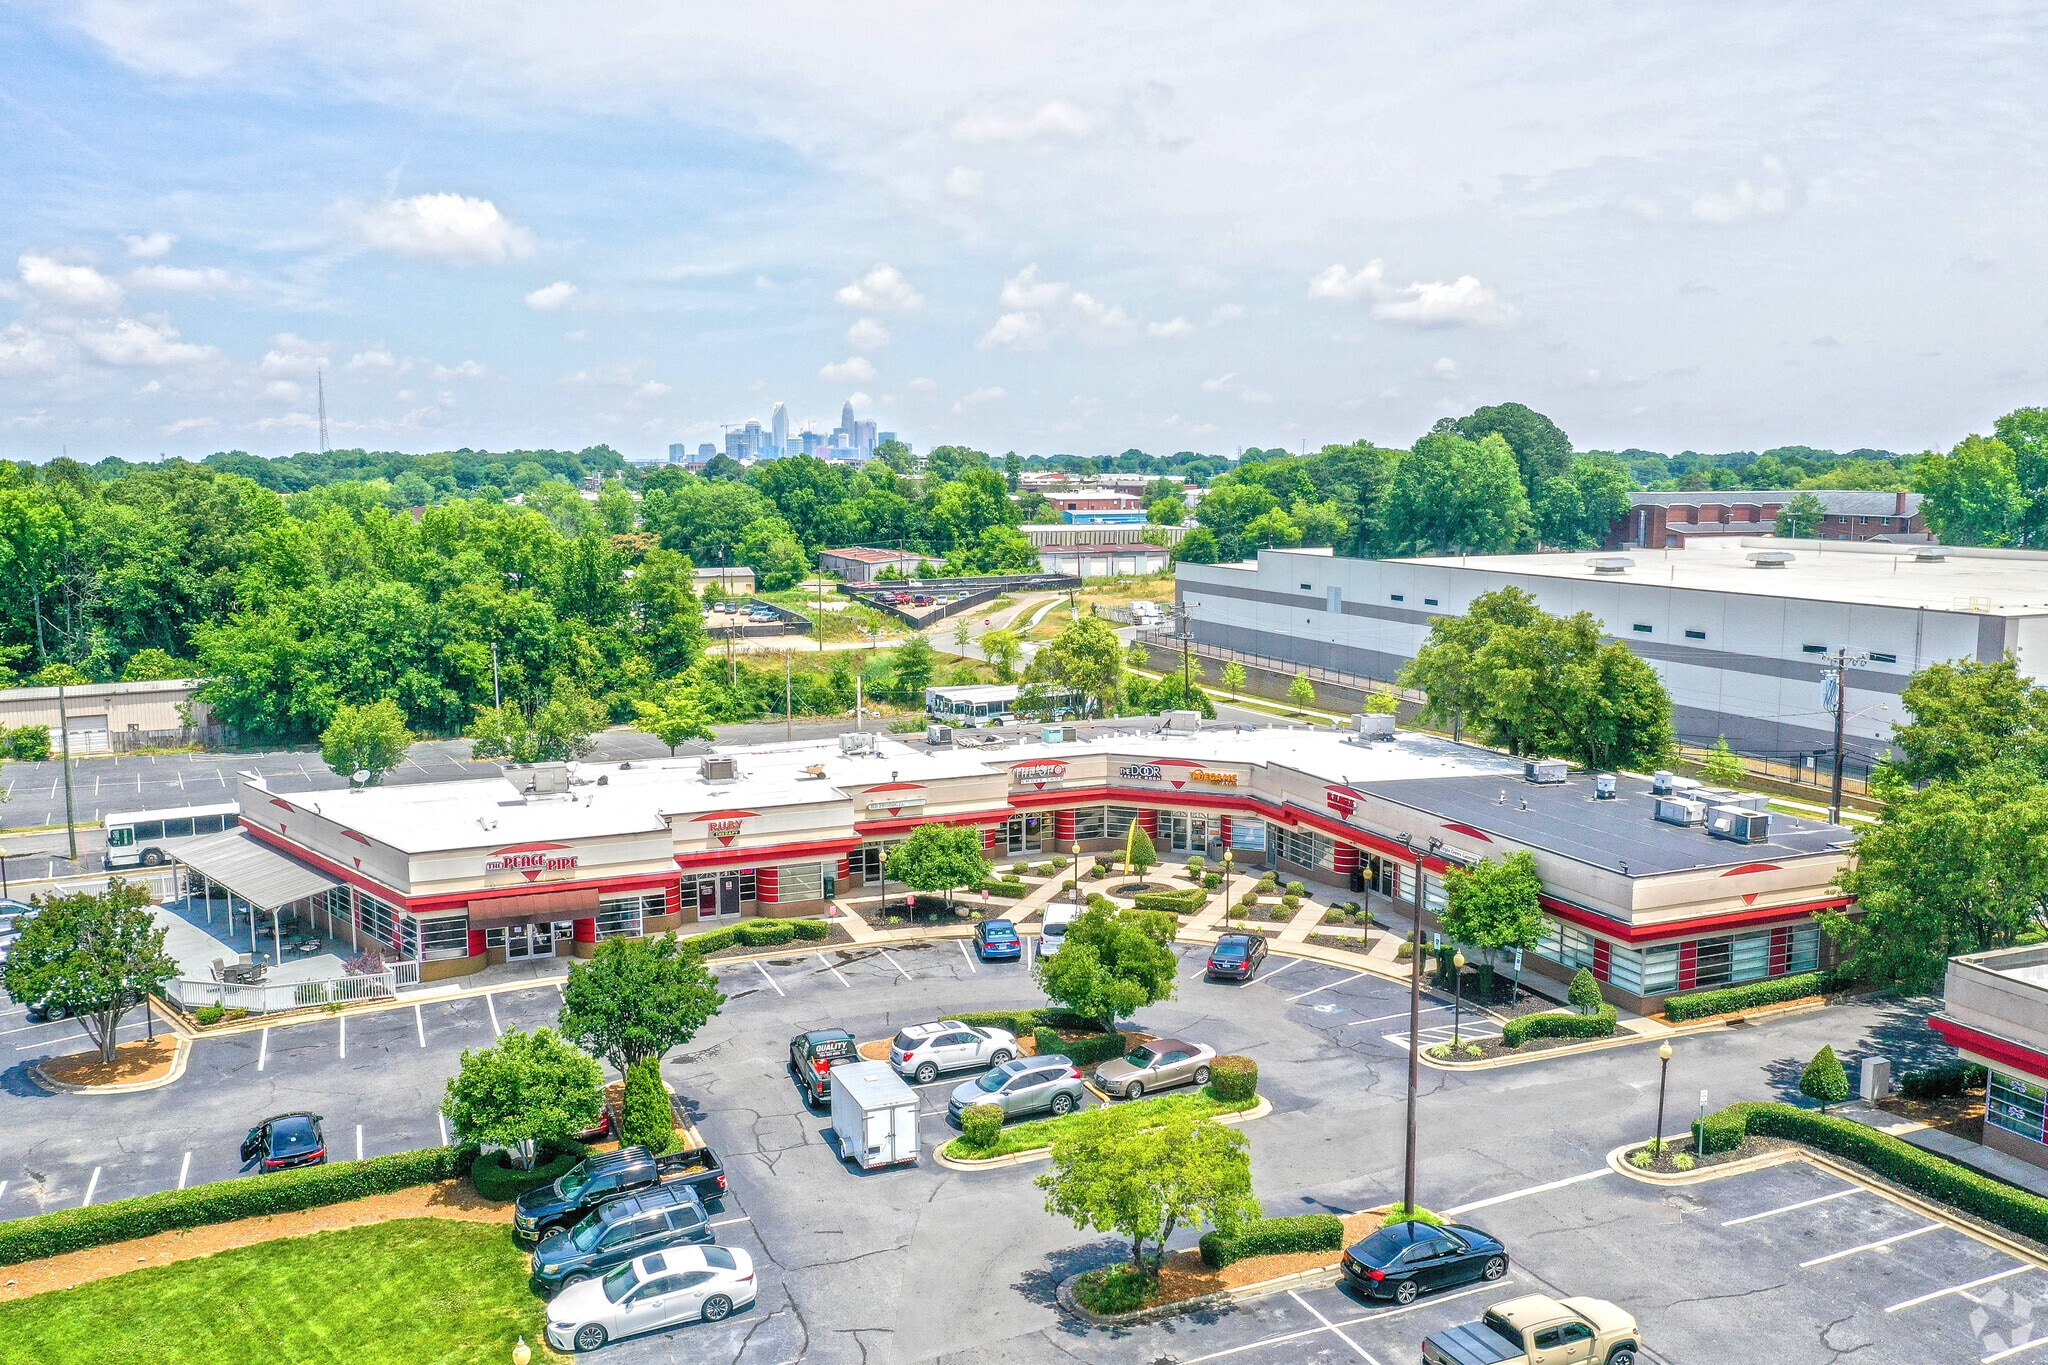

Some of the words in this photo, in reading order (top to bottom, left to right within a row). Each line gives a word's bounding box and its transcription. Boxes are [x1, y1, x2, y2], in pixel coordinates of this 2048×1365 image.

[1131, 765, 1161, 777] DOOR
[710, 820, 743, 832] RUBY
[487, 861, 503, 870] THE
[503, 853, 546, 869] PEACE
[547, 856, 578, 871] PIPE
[816, 1042, 847, 1052] QUALITY
